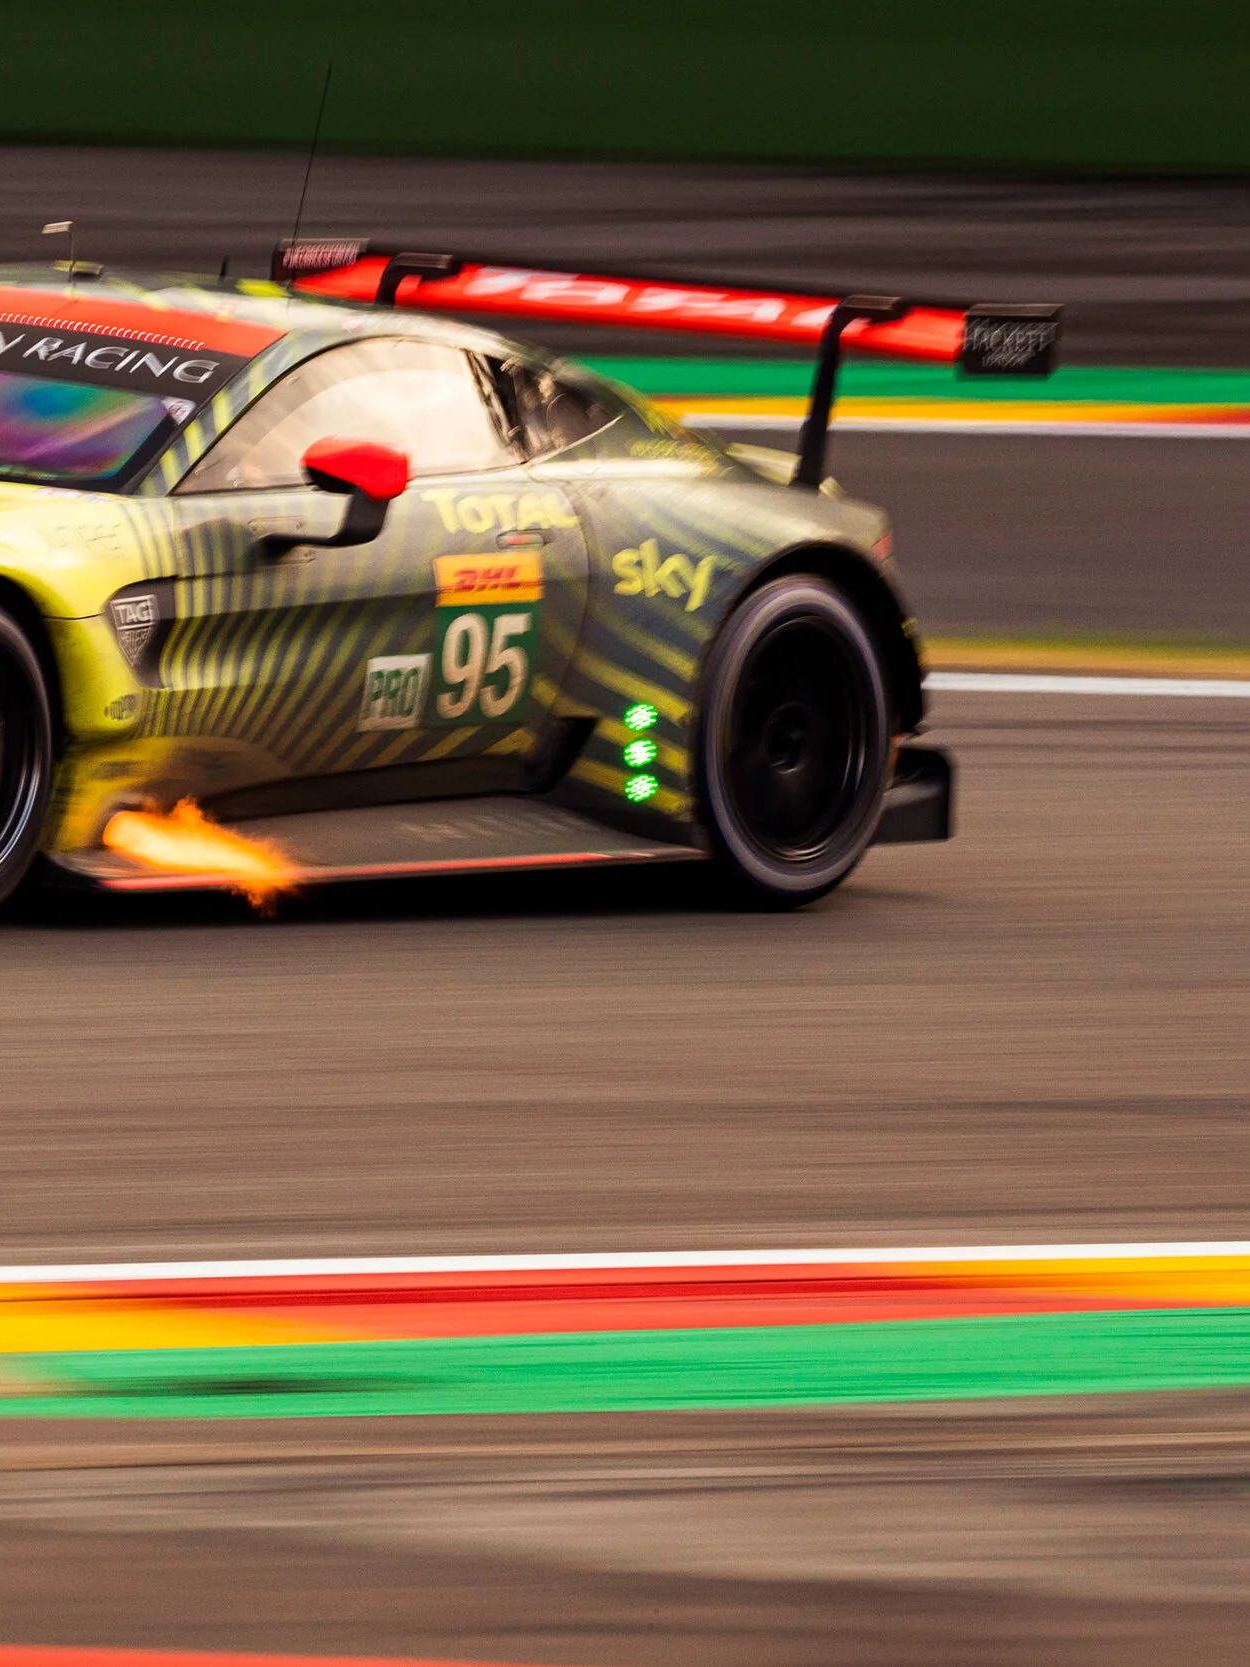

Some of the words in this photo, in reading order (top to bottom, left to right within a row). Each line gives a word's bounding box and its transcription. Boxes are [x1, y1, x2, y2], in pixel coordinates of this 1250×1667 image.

[22, 336, 220, 384] RACING
[421, 487, 581, 534] TOTAL
[453, 566, 521, 592] DHL
[612, 538, 718, 612] sky
[114, 600, 158, 625] TAG
[436, 612, 533, 719] 95
[364, 668, 420, 718] PRO
